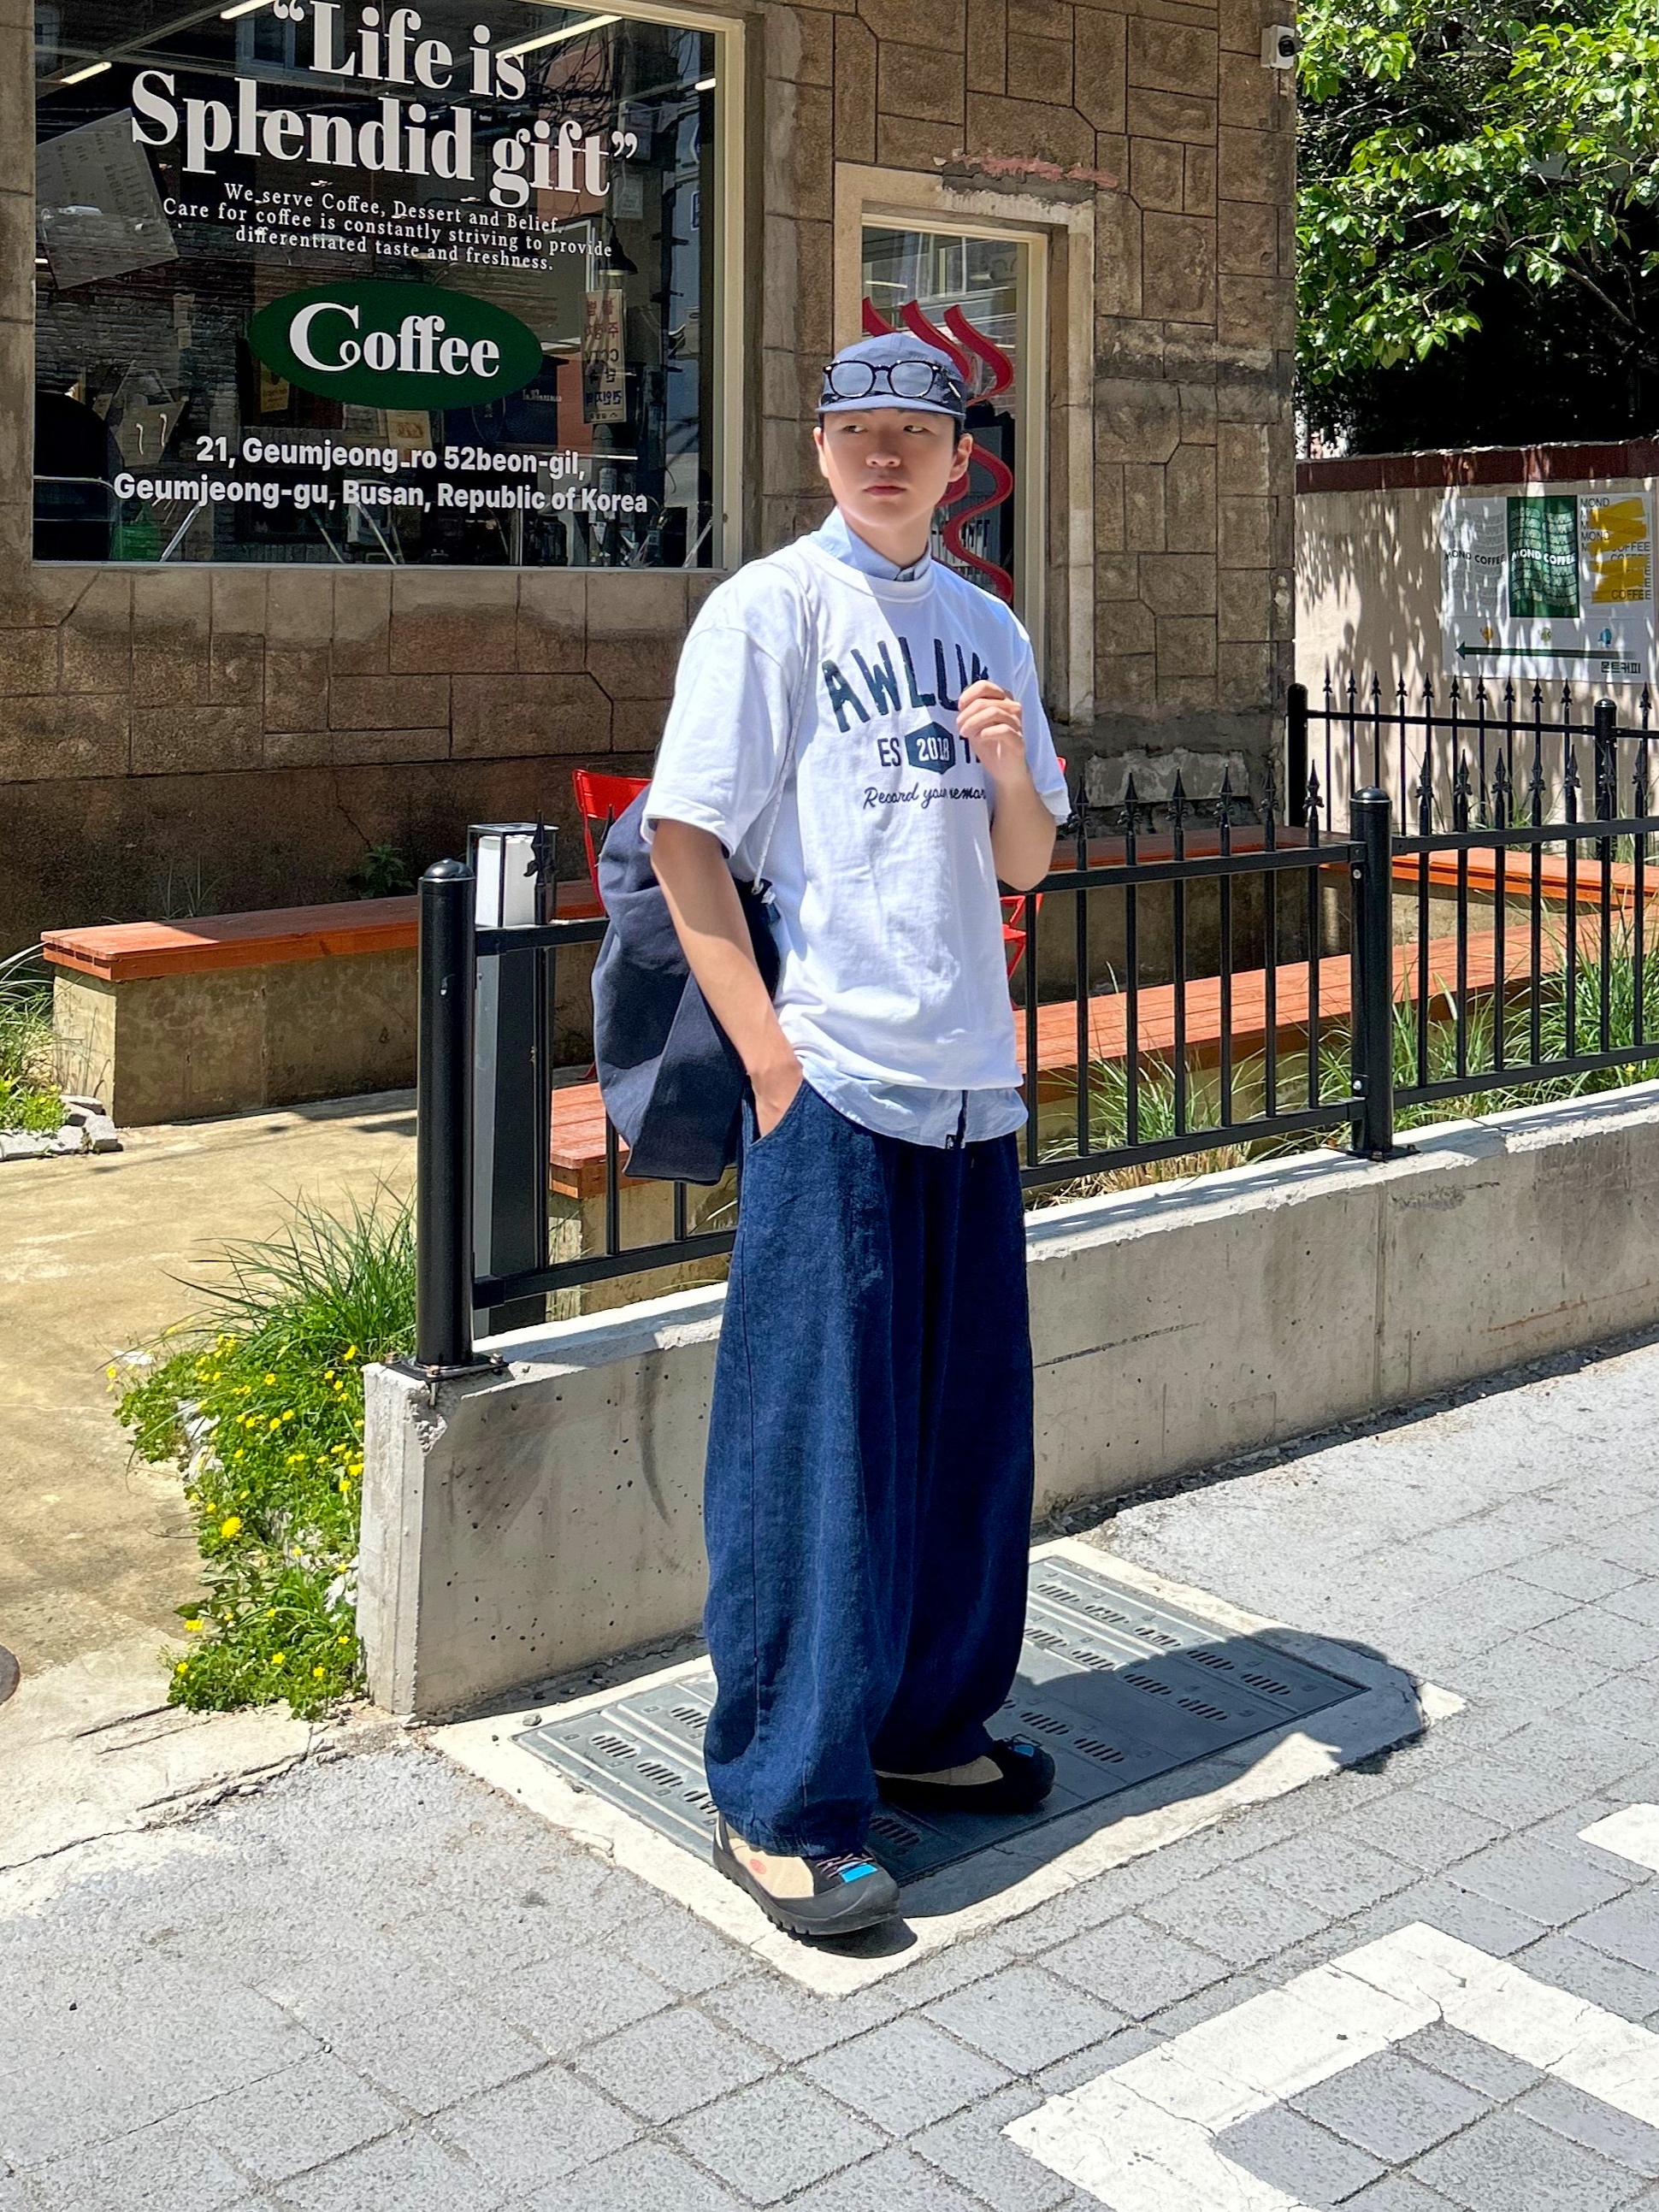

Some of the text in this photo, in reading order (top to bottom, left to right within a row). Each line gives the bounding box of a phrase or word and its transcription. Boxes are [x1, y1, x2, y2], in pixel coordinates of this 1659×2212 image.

[469, 25, 526, 100] is
[132, 70, 475, 181] Splendid
[163, 198, 612, 257] Care for coffee is constantly striving to provide
[224, 182, 563, 234] We serve Coffee, Dessert and Belief.
[236, 225, 552, 271] differentiated taste and freshness.
[289, 302, 500, 377] Coffee
[196, 436, 235, 469] 21,
[444, 446, 585, 481] 52beon-gil,
[113, 473, 647, 513] Geumjeong-gu, Busan, Republic of Korea
[1474, 554, 1505, 565] COFFEE
[1543, 552, 1576, 565] COFFEE
[1611, 589, 1651, 600] COFFEE
[916, 737, 950, 761] 2018
[863, 782, 918, 810] Record
